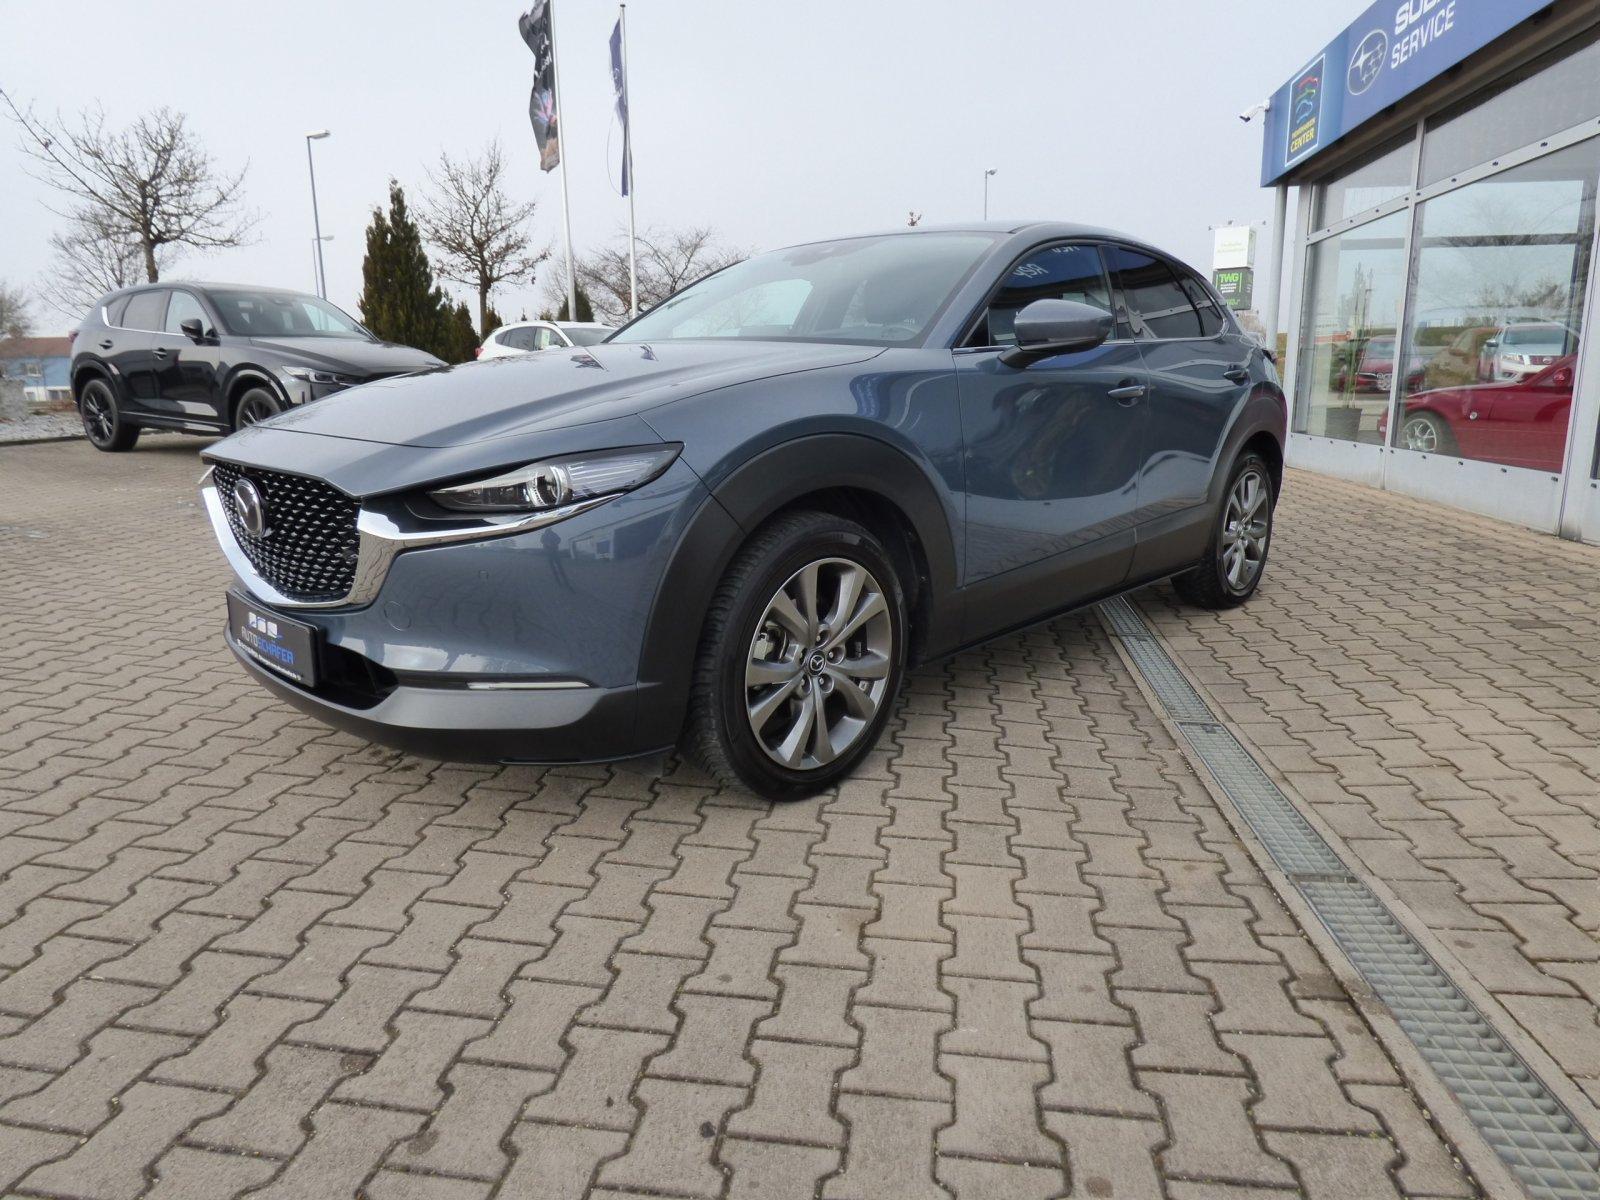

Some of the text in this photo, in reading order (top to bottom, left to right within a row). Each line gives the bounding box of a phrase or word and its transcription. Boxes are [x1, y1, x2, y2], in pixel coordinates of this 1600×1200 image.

[1394, 0, 1442, 35] SU
[1390, 0, 1456, 69] SERVICE
[1290, 127, 1315, 153] CENTER
[1218, 272, 1239, 283] TWG
